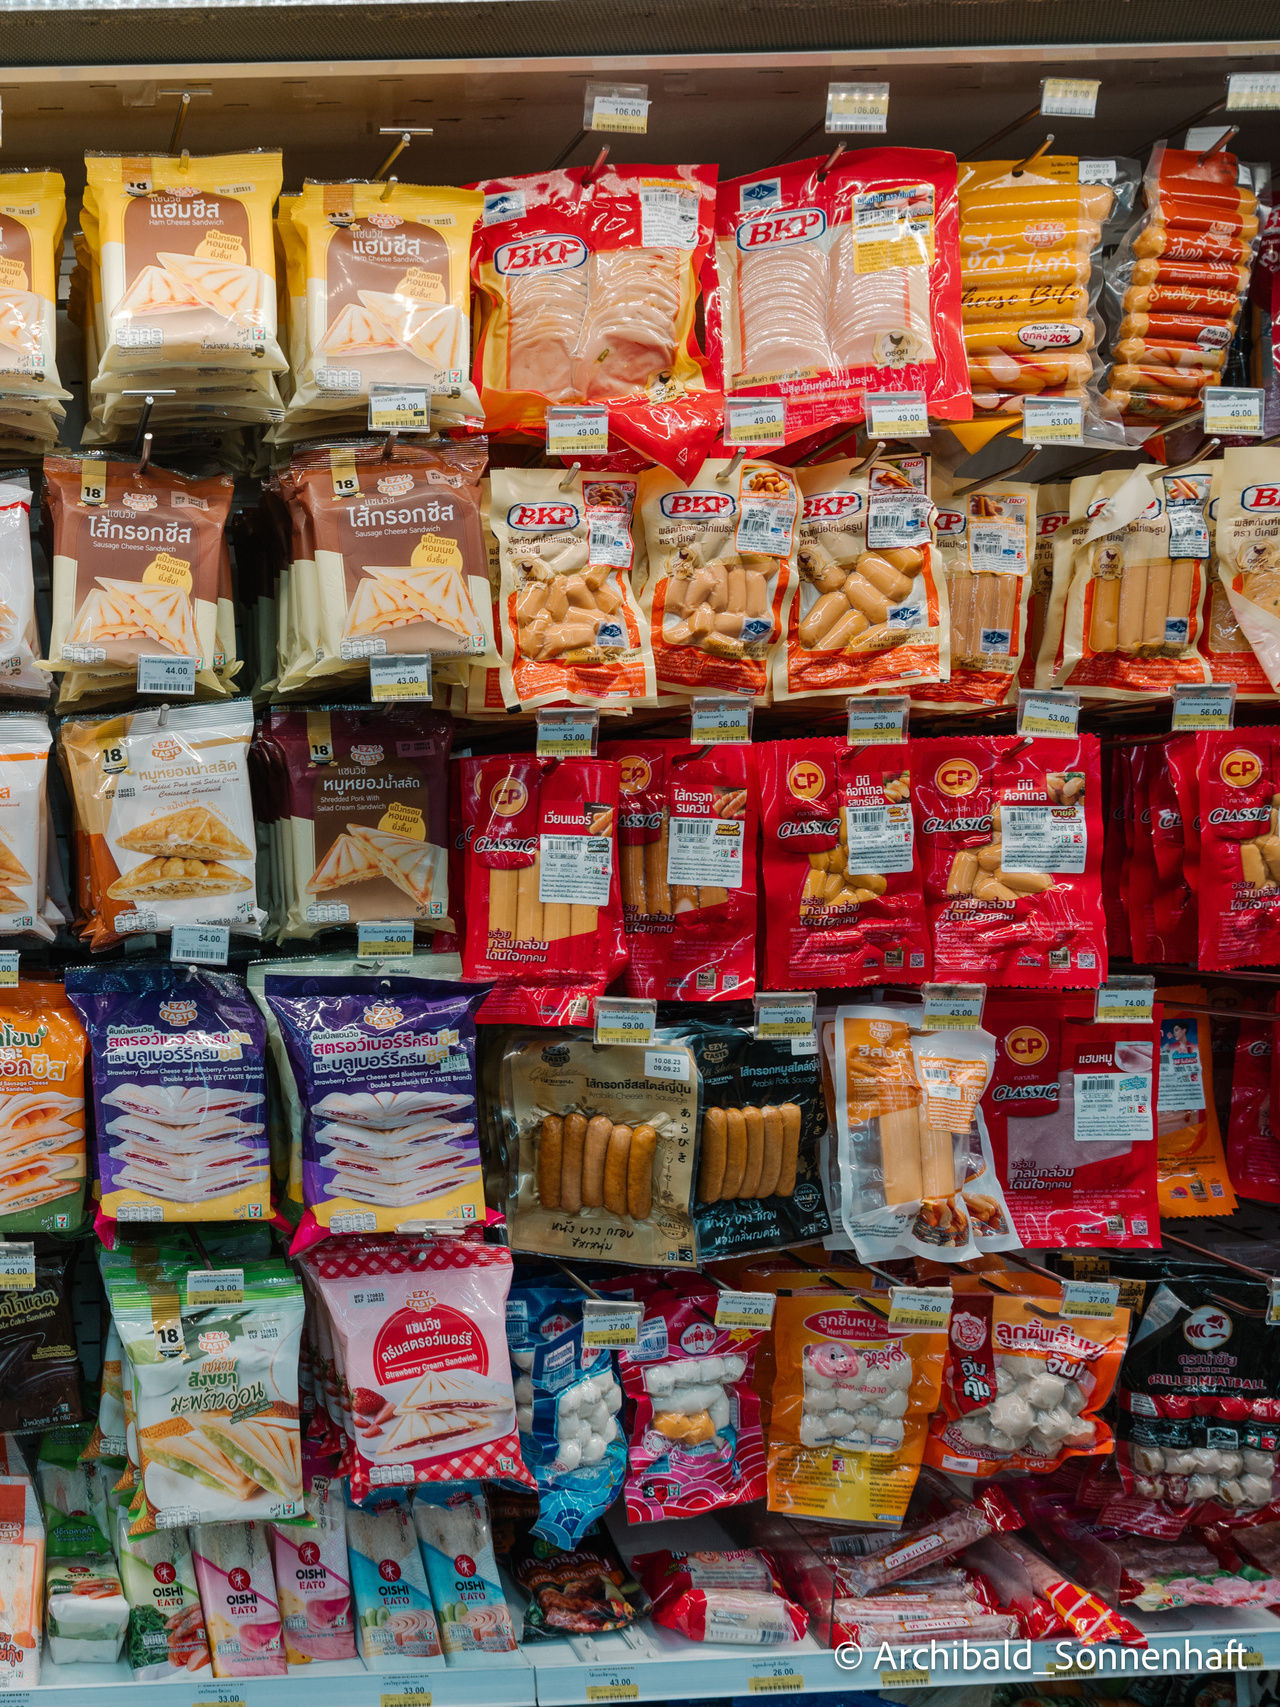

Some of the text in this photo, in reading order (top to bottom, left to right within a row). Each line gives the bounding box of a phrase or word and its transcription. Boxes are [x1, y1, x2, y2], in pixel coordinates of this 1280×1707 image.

[853, 106, 880, 115] 106.00
[747, 213, 820, 244] BKP
[502, 241, 581, 271] BKP
[961, 285, 1081, 309] heese Bite
[1050, 331, 1071, 343] 20%
[1050, 417, 1073, 426] 53.00
[577, 428, 599, 436] 49.00
[83, 486, 101, 498] 18
[670, 496, 734, 516] BKP
[514, 508, 579, 527] BKP
[88, 516, 192, 543] ไส้กรอกชีส
[93, 541, 176, 553] Sausage Cheese Sandwich
[165, 666, 188, 675] 44.00
[563, 733, 584, 741] 53.00
[311, 745, 328, 757] 18
[1226, 760, 1255, 777] CP
[323, 774, 419, 792] หมูหยองน้ำสลัด
[793, 773, 819, 789] CP
[855, 774, 871, 786] มินิ
[940, 769, 973, 785] CP
[846, 785, 883, 796] ค็อกเทล
[1017, 779, 1033, 791] มินิ
[495, 789, 521, 807] CP
[674, 788, 712, 802] ไส้กรอก
[1004, 789, 1047, 801] ค็อกเทล
[676, 801, 710, 814] รมควัน
[1209, 804, 1271, 823] CLASSIC
[544, 810, 591, 825] เวียนเนอร์
[778, 819, 840, 837] CLASSIC
[923, 815, 993, 833] CLASSIC
[474, 837, 538, 853] CLASSIC
[385, 934, 407, 943] 54.00
[1125, 999, 1145, 1007] 74.00
[950, 1009, 972, 1017] 43.00
[622, 1021, 644, 1029] 59.00
[1011, 1038, 1042, 1054] CP
[1079, 1053, 1113, 1066] แฮมหมู
[107, 1069, 140, 1077] Strawberry
[162, 1067, 180, 1075] Cheese
[193, 1066, 222, 1074] Blueberry
[654, 1065, 681, 1073] 09.09.23
[163, 1073, 184, 1082] Double
[185, 1073, 212, 1081] Sandwich
[229, 1072, 244, 1080] TASTE
[993, 1084, 1059, 1101] CLASSIC
[679, 1108, 690, 1164] あらびき
[214, 1284, 237, 1293] 43.00
[1088, 1296, 1110, 1304] 37.00
[919, 1303, 941, 1311] 36.00
[14, 1317, 27, 1328] Cake
[27, 1310, 56, 1324] Sandwich
[406, 1317, 441, 1335] แซนวิช
[827, 1327, 853, 1336] Meat Ball
[158, 1328, 178, 1343] 18
[386, 1353, 477, 1378] Strawberry Cream Sandwich
[189, 1371, 237, 1389] สังขยา
[1200, 1375, 1266, 1390] MEATBALL
[152, 1587, 184, 1597] OISHI
[158, 1598, 183, 1606] EATO
[227, 1594, 257, 1605] OISHI
[231, 1606, 257, 1614] EATO
[773, 1668, 794, 1676] 26.00
[610, 1678, 631, 1687] 43.00
